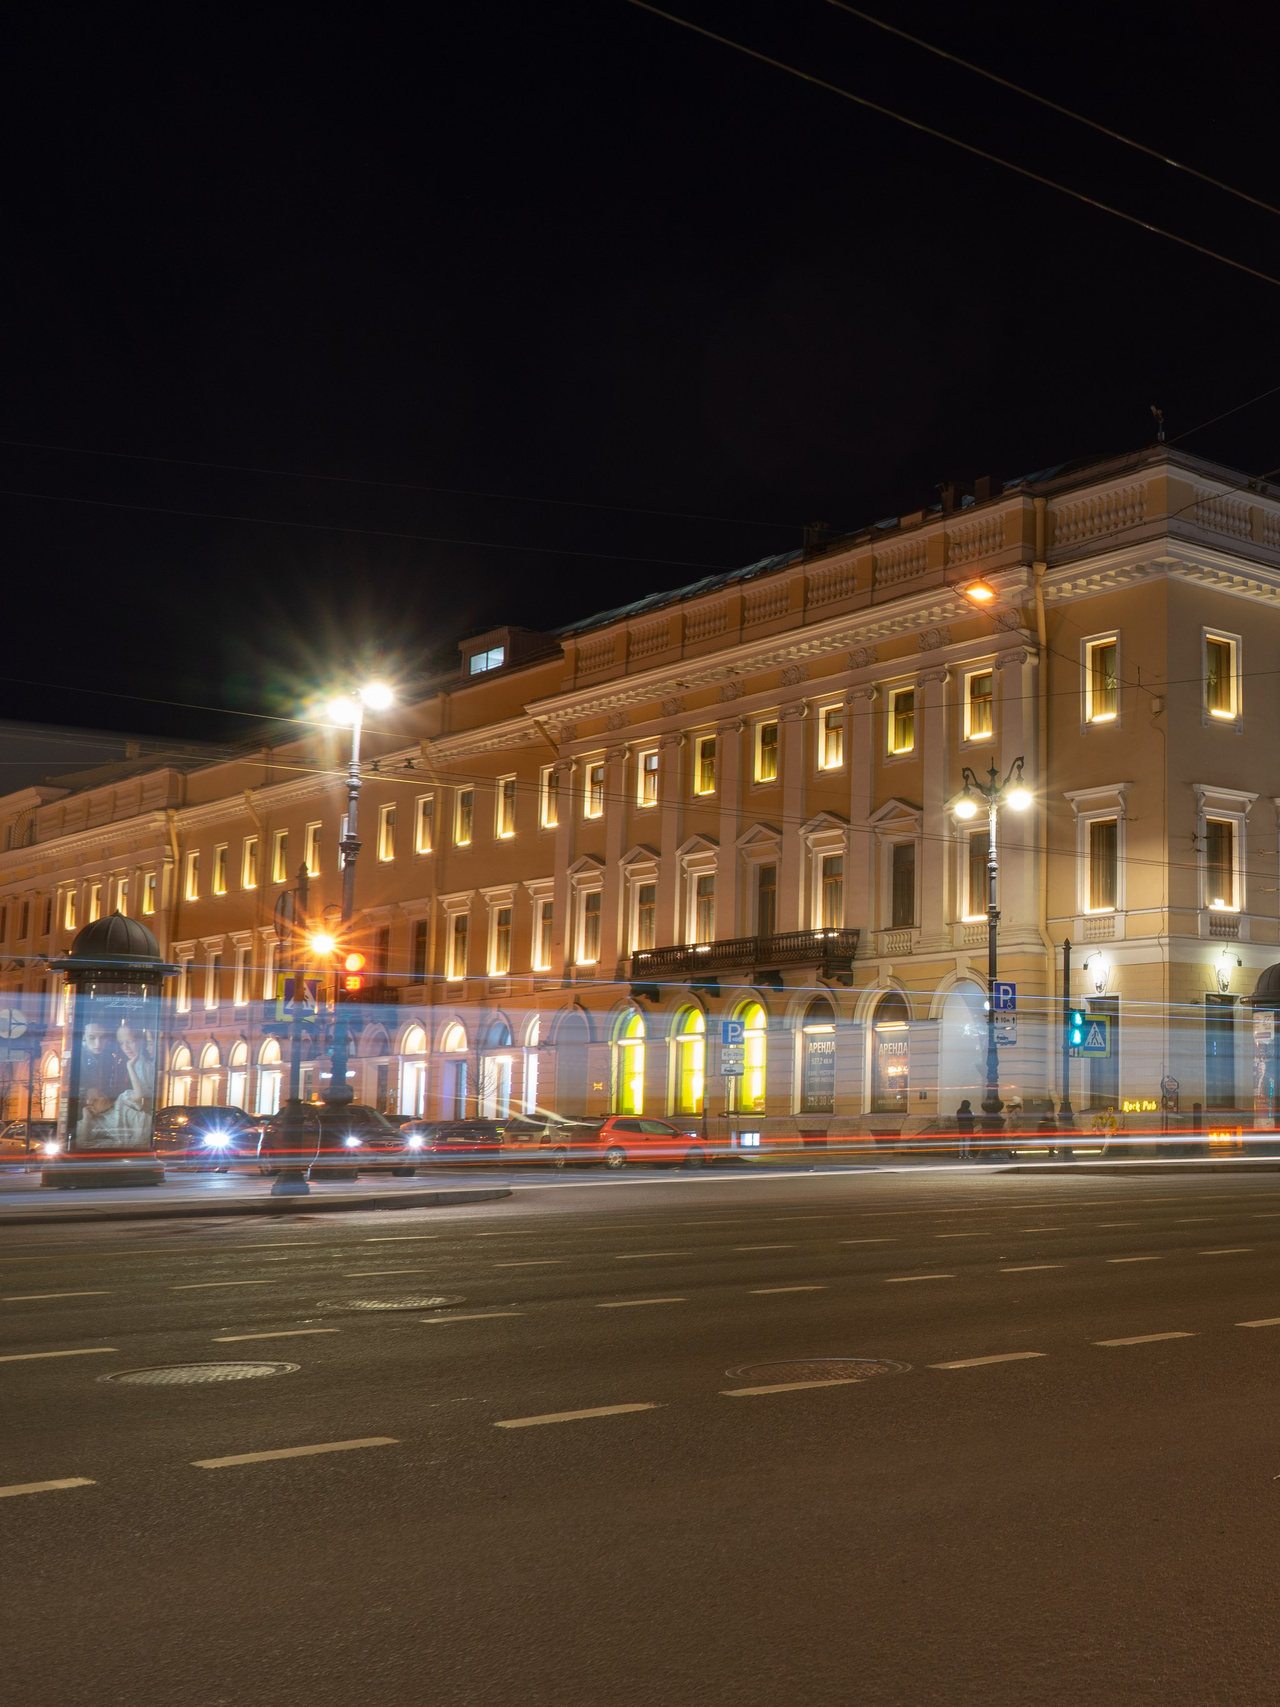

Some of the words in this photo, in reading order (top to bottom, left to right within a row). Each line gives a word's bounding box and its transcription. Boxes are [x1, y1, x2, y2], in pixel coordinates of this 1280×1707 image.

[1000, 985, 1013, 1008] P
[728, 1023, 742, 1043] P
[808, 1041, 836, 1054] АРЕНДА
[879, 1042, 908, 1056] АРЕНДА
[1123, 1100, 1141, 1113] Rock
[1142, 1100, 1157, 1111] Pub
